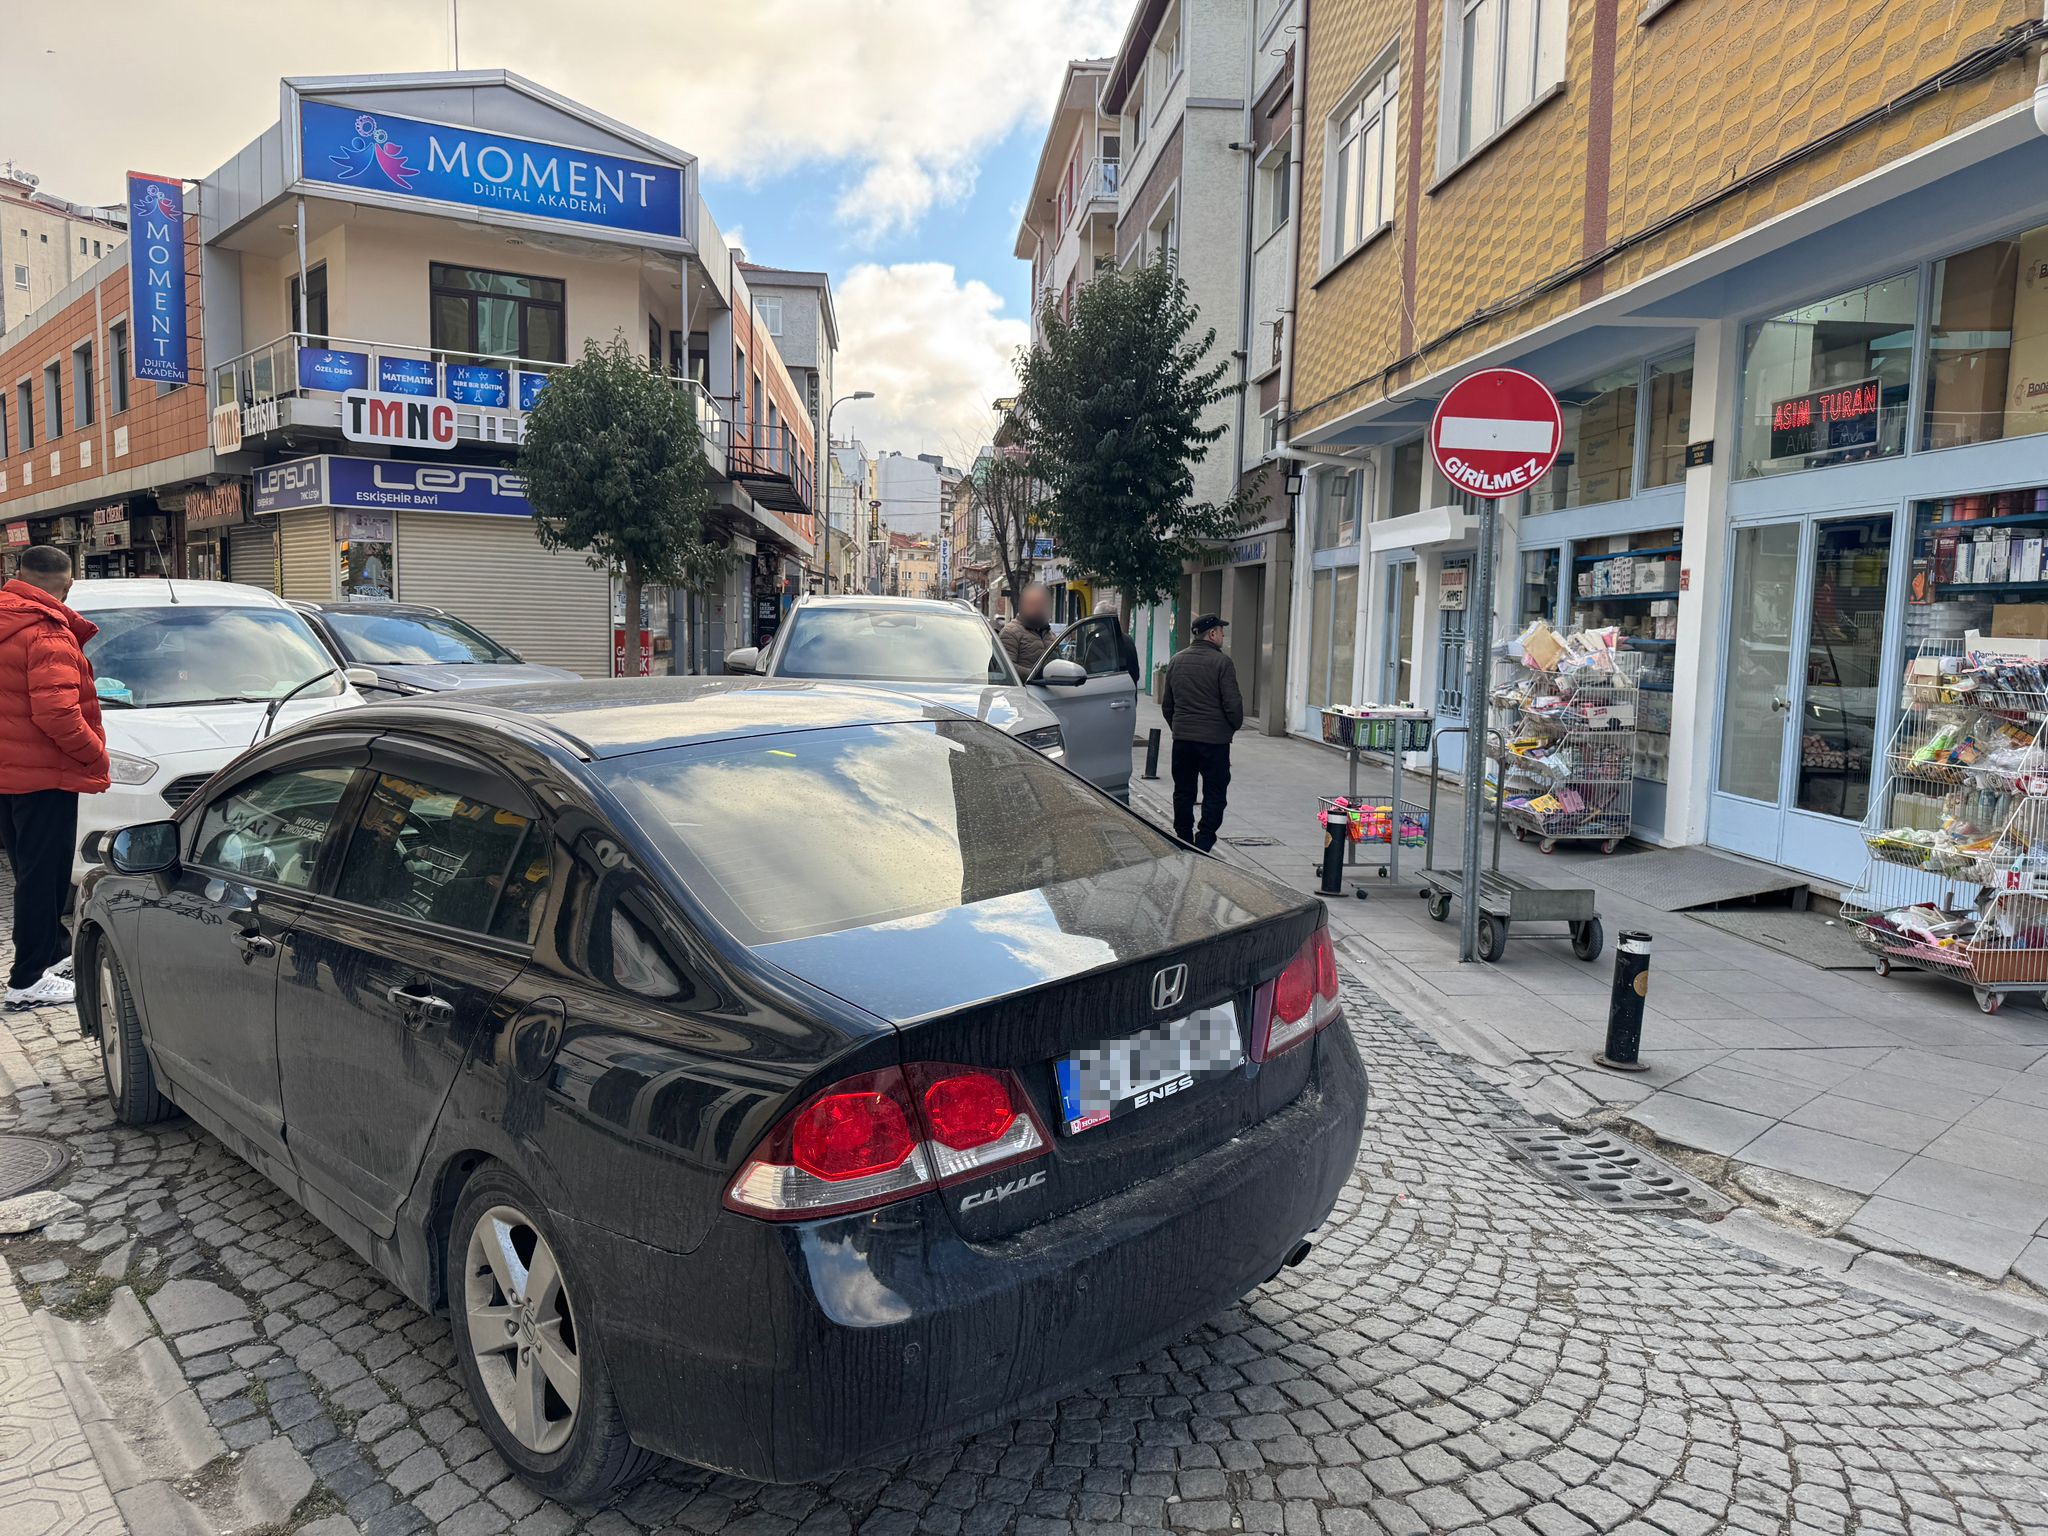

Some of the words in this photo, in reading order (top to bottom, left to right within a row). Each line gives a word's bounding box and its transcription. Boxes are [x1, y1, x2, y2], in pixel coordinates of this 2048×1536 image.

[428, 136, 656, 208] MOMENT
[147, 221, 172, 357] MOMENT
[314, 363, 333, 376] ÖZEL
[334, 368, 353, 376] DERS
[215, 408, 240, 449] TMNC
[244, 395, 278, 441] İLETİŞİM
[347, 396, 454, 443] TMNC
[1773, 399, 1811, 432] ASIM
[1819, 384, 1877, 423] TURAN
[1444, 456, 1543, 490] GİRİLMEZ
[356, 490, 411, 505] ESKİŞEHİR
[414, 494, 438, 505] BAYİ
[1134, 1075, 1194, 1110] ENES
[960, 1169, 1047, 1212] CIVIC
